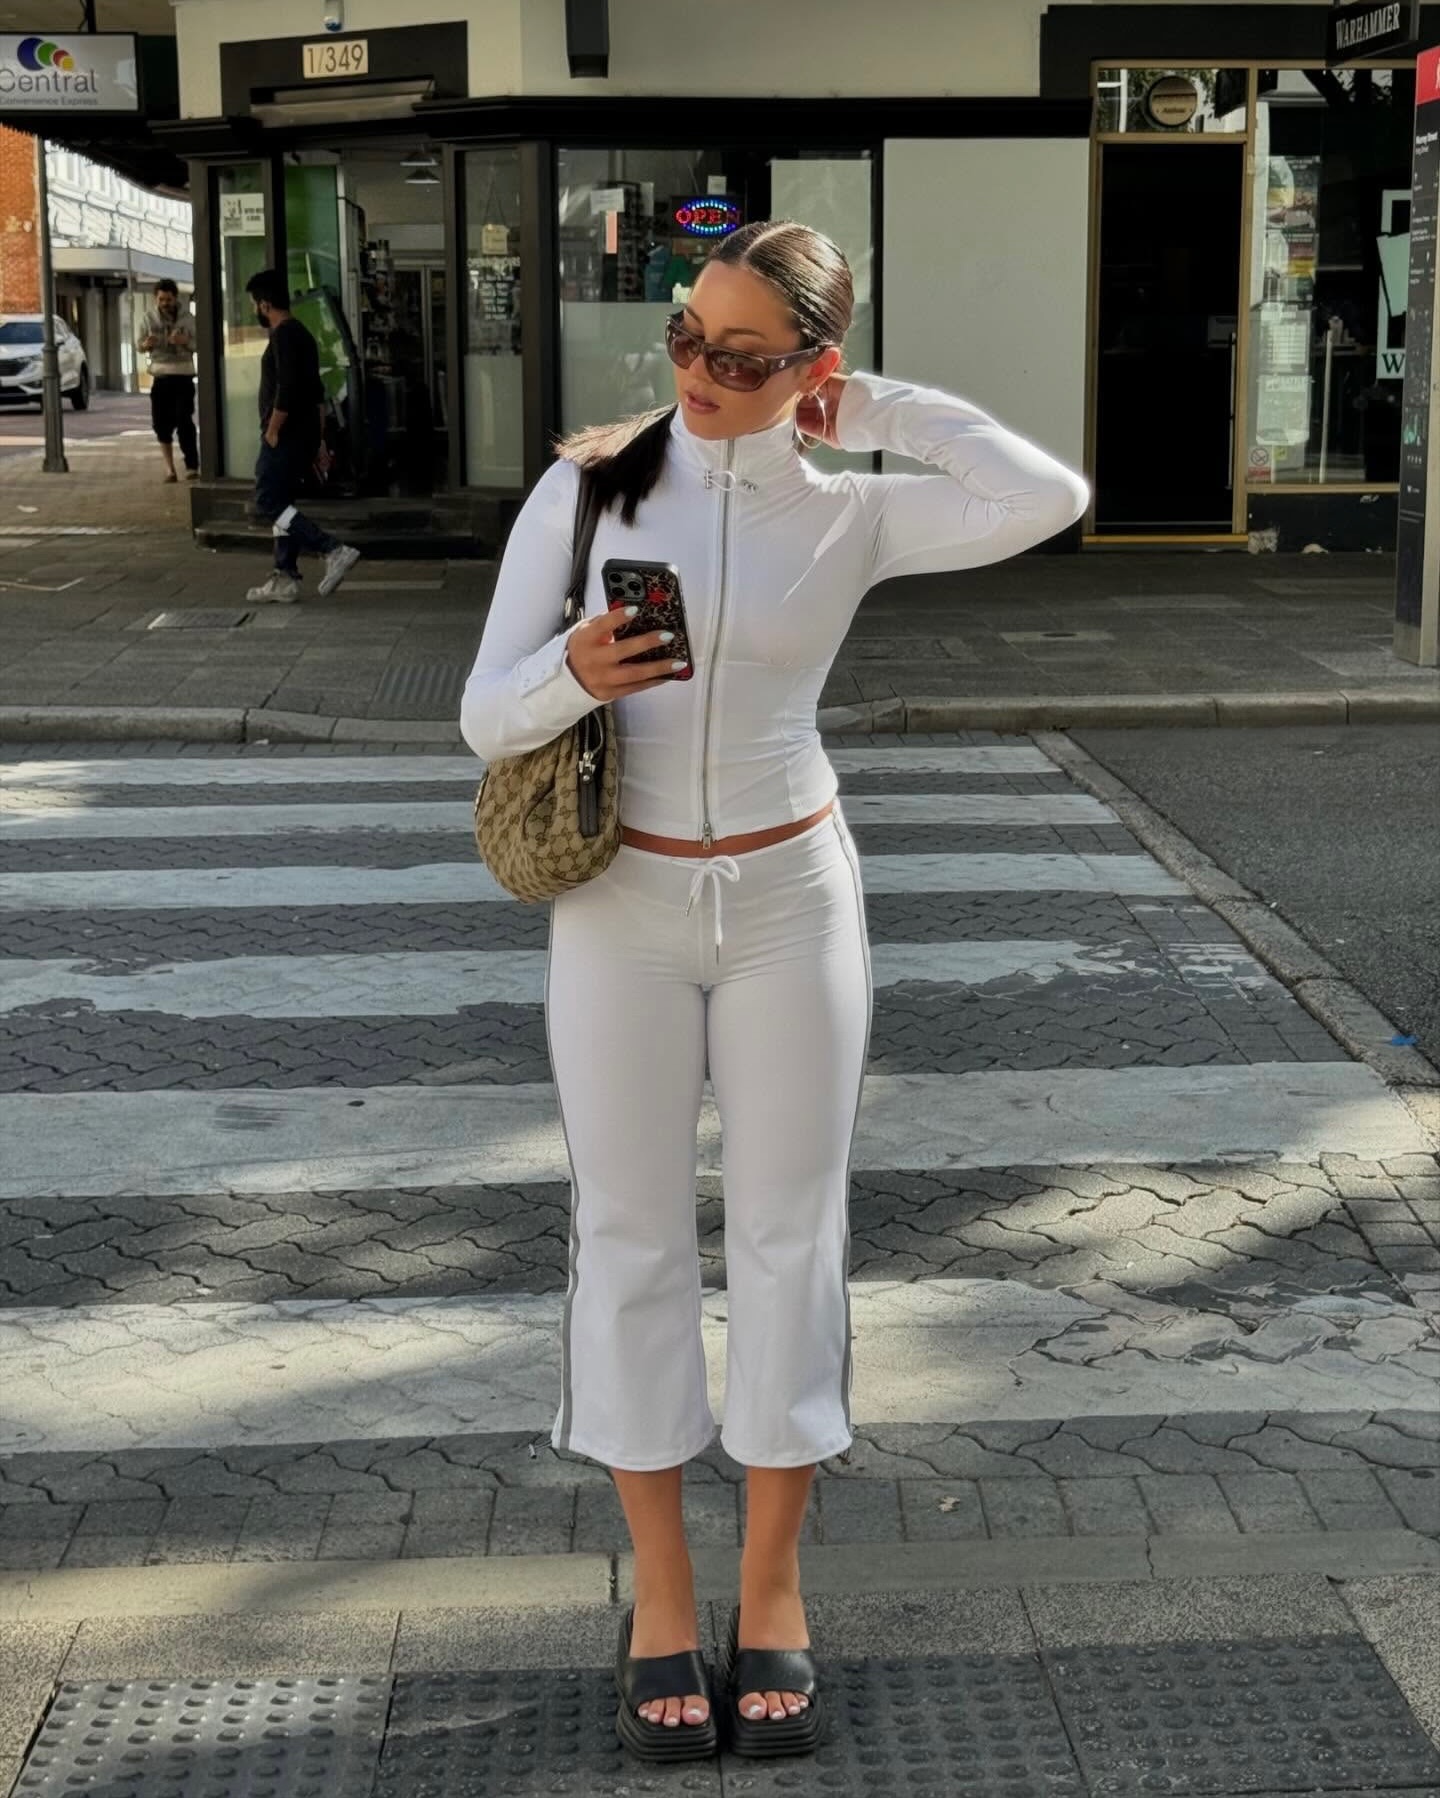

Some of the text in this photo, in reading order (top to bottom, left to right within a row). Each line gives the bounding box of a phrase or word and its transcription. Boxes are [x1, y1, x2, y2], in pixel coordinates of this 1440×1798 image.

[1336, 2, 1400, 50] WARHAMMER
[307, 44, 364, 73] 1/349
[0, 69, 98, 93] Central
[61, 97, 98, 106] Express
[675, 208, 742, 225] OPEN
